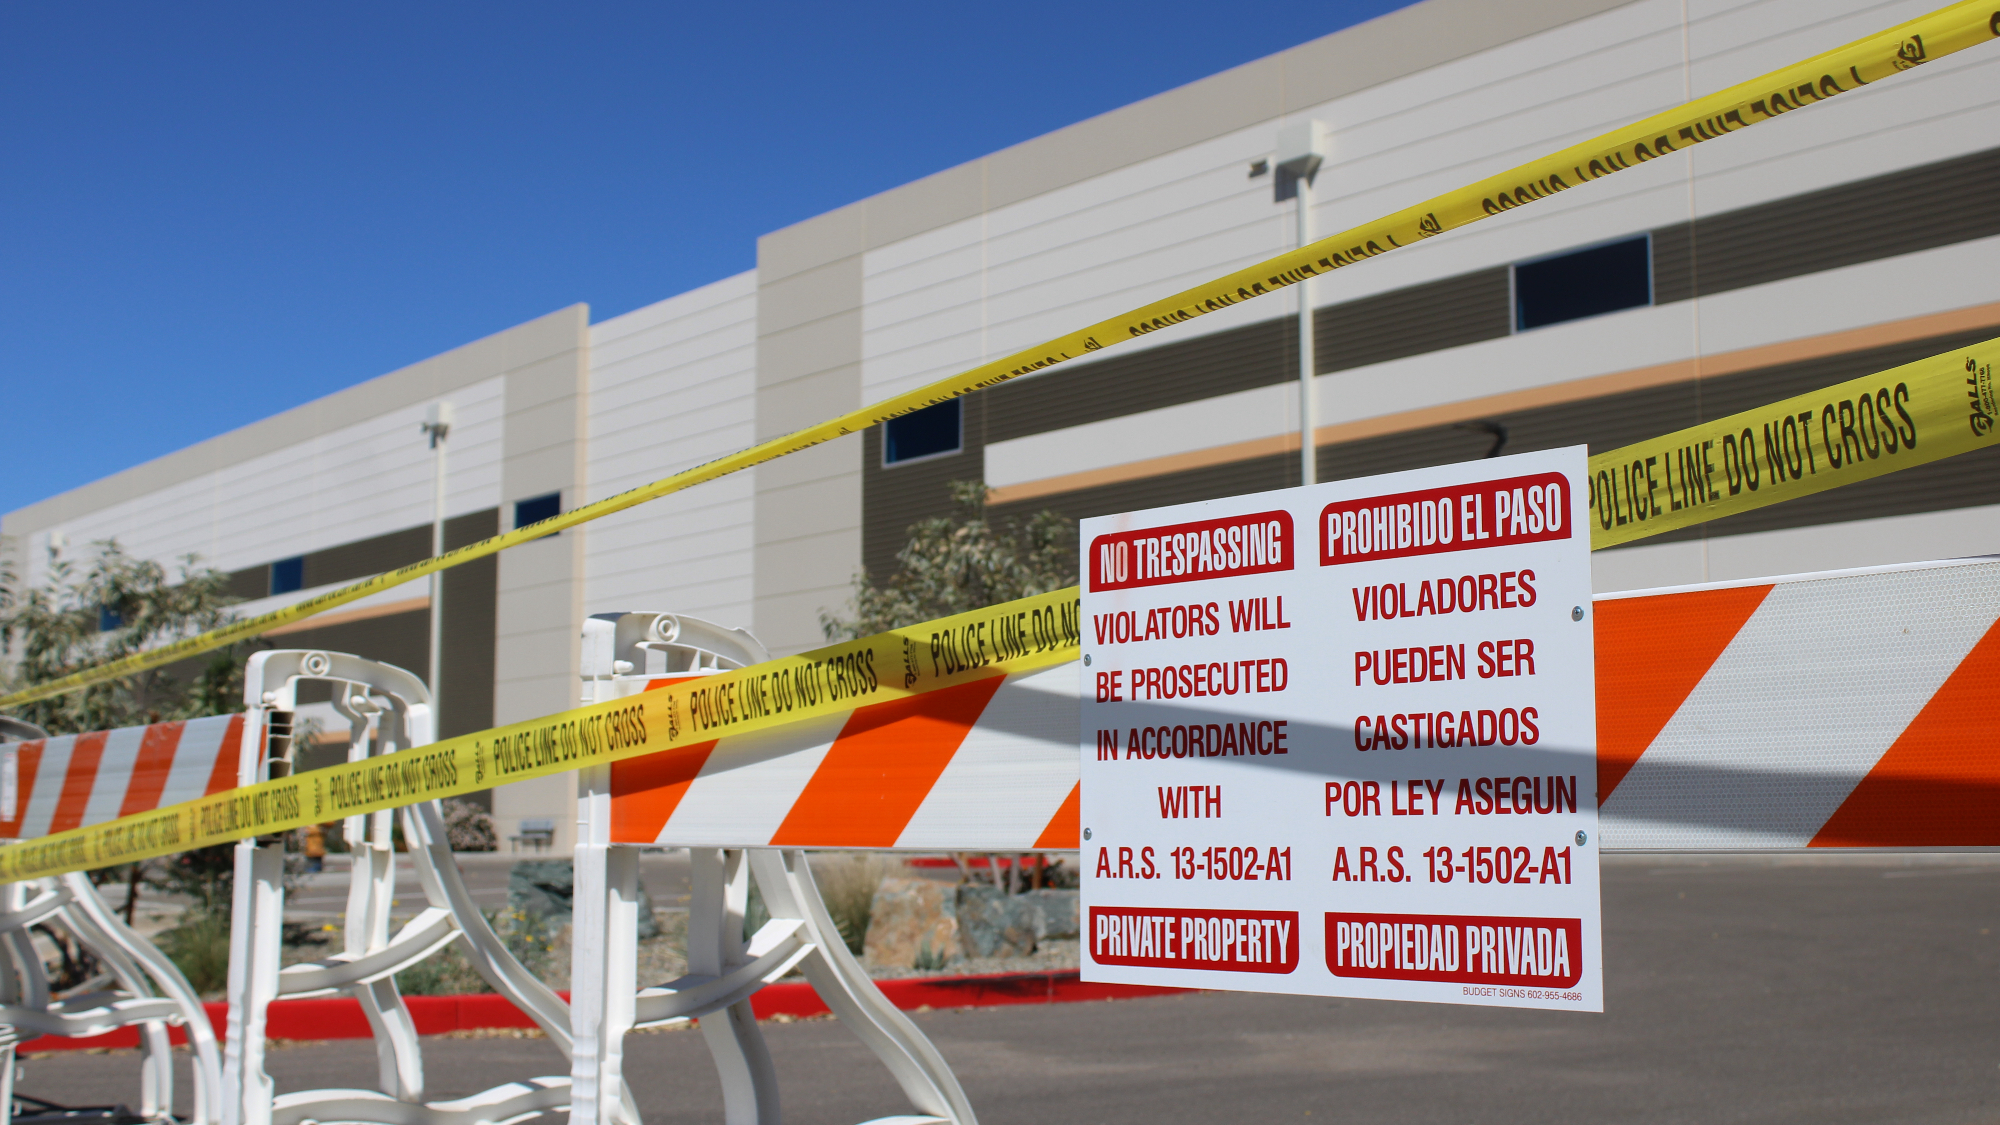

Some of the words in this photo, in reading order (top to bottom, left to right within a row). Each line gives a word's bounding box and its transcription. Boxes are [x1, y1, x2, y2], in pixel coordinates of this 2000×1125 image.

[1664, 439, 1720, 512] LINE
[1723, 427, 1760, 496] DO
[1763, 410, 1817, 485] NOT
[1821, 382, 1917, 470] CROSS
[1327, 497, 1453, 557] PROHIBIDO
[1461, 494, 1486, 541] EL
[1495, 483, 1562, 537] PASO
[1100, 541, 1128, 584] NO
[1134, 520, 1281, 579] TRESPASSING
[1094, 602, 1219, 645] VIOLATORS
[1229, 596, 1291, 633] WILL
[1352, 569, 1537, 622] VIOLADORES
[931, 622, 990, 677] POLICE
[990, 612, 1030, 663] LINE
[1032, 605, 1059, 653] DO
[1061, 598, 1080, 647] NO
[1096, 670, 1124, 704] BE
[1131, 658, 1288, 700] PROSECUTED
[1355, 644, 1465, 687] PUEDEN
[1477, 639, 1536, 678] SER
[690, 682, 737, 732] POLICE
[738, 674, 770, 721] LINE
[771, 668, 793, 713] DO
[794, 661, 824, 709] NOT
[826, 648, 878, 702] CROSS
[493, 731, 532, 776] POLICE
[533, 725, 559, 767] LINE
[560, 720, 577, 761] DO
[579, 715, 602, 757] NOT
[605, 703, 647, 751] CROSS
[1097, 729, 1118, 762] IN
[1127, 720, 1288, 760] ACCORDANCE
[1355, 707, 1539, 752] CASTIGADOS
[330, 771, 362, 810] POLICE
[363, 766, 385, 803] LINE
[385, 762, 400, 798] DO
[401, 757, 421, 795] NOT
[422, 749, 457, 791] CROSS
[1158, 785, 1222, 819] WITH
[1326, 781, 1380, 817] POR
[1392, 778, 1445, 816] LEY
[1455, 775, 1577, 815] ASEGUN
[1096, 846, 1161, 879] A.R.S.
[1170, 846, 1292, 882] 13-1502-A1
[1333, 847, 1411, 883] A.R.S.
[1423, 846, 1572, 885] 13-1502-A1
[1097, 914, 1175, 960] PRIVATE
[1181, 917, 1291, 965] PROPERTY
[1338, 921, 1459, 973] PROPIEDAD
[1466, 925, 1571, 978] PRIVADA
[1463, 986, 1497, 997] BUDGET
[1499, 988, 1525, 999] SIGNS
[1528, 990, 1583, 1001] 602-955-4686
